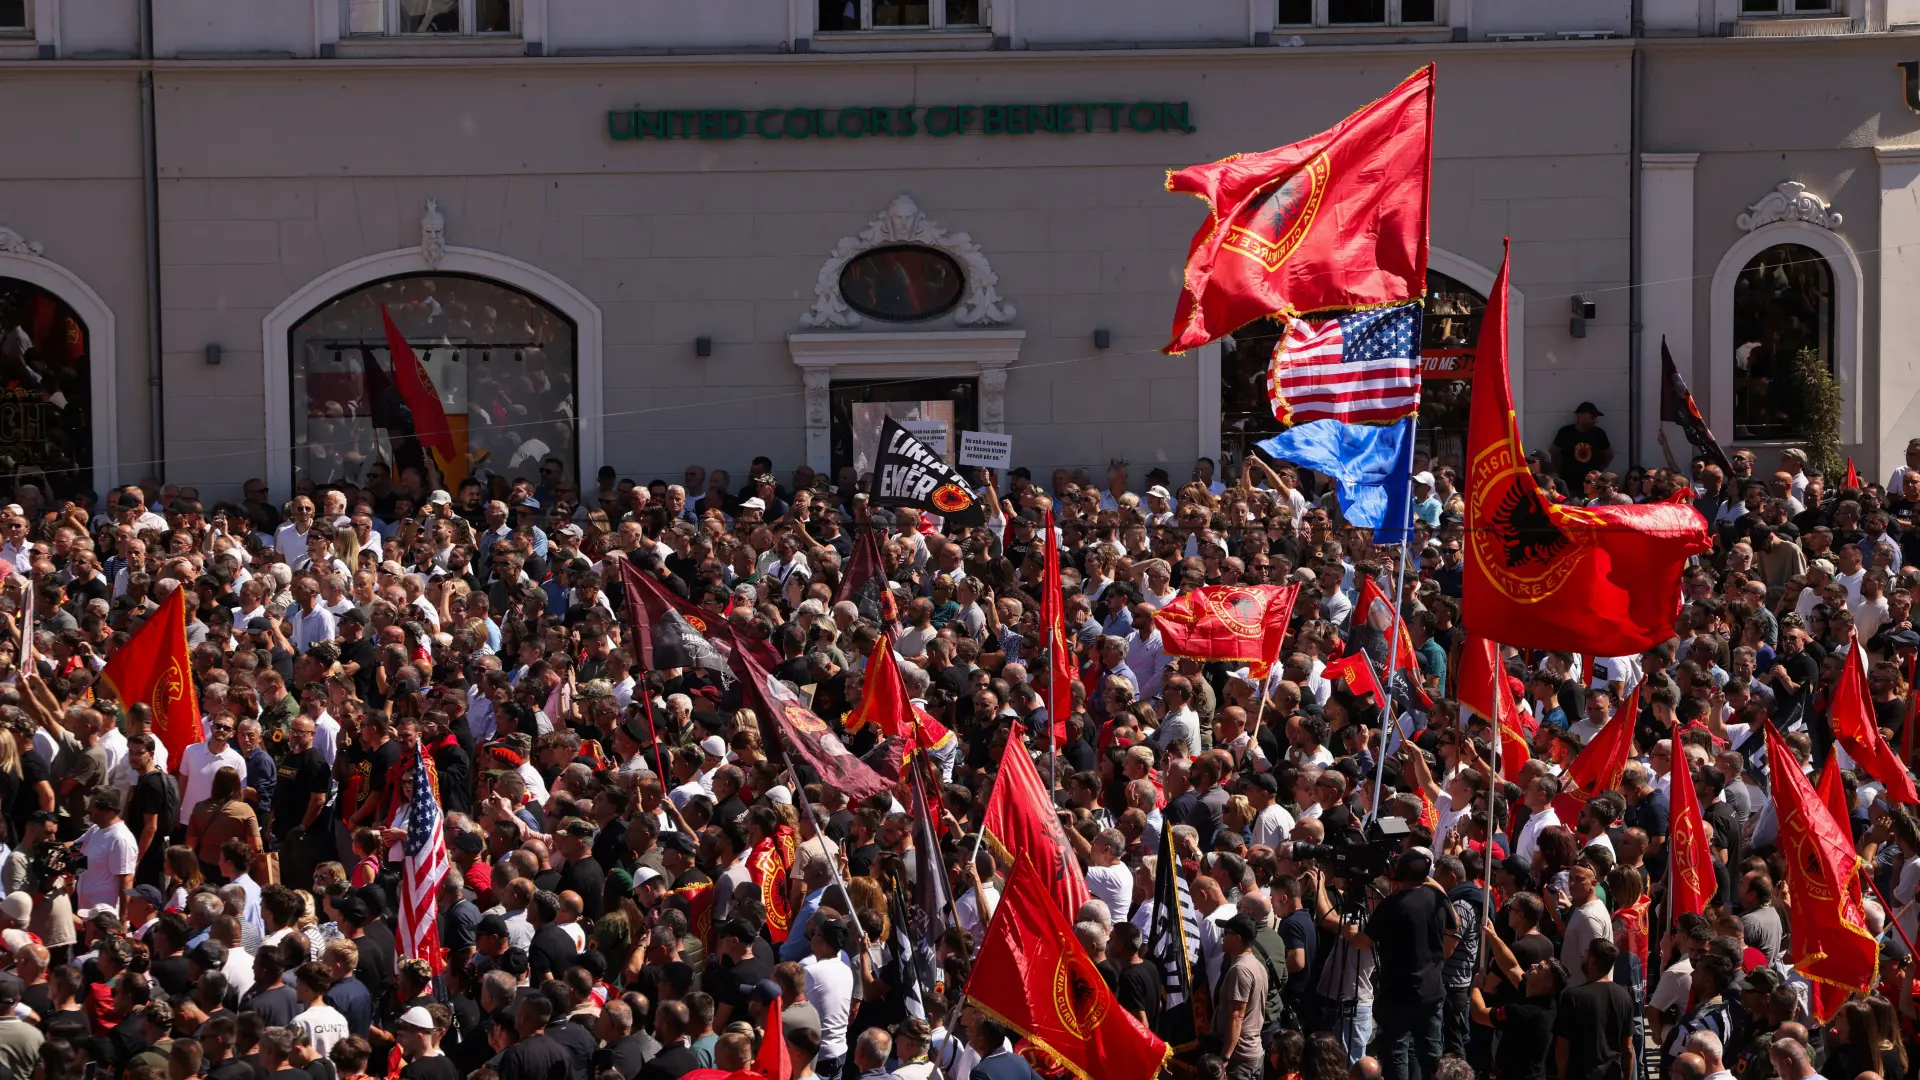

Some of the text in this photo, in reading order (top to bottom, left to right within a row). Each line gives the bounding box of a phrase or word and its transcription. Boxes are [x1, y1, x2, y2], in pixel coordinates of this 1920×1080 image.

[608, 109, 748, 141] UNITED
[755, 104, 918, 139] COLORS
[924, 104, 976, 137] OF
[888, 429, 949, 475] LIRIA
[880, 463, 938, 501] EMËR
